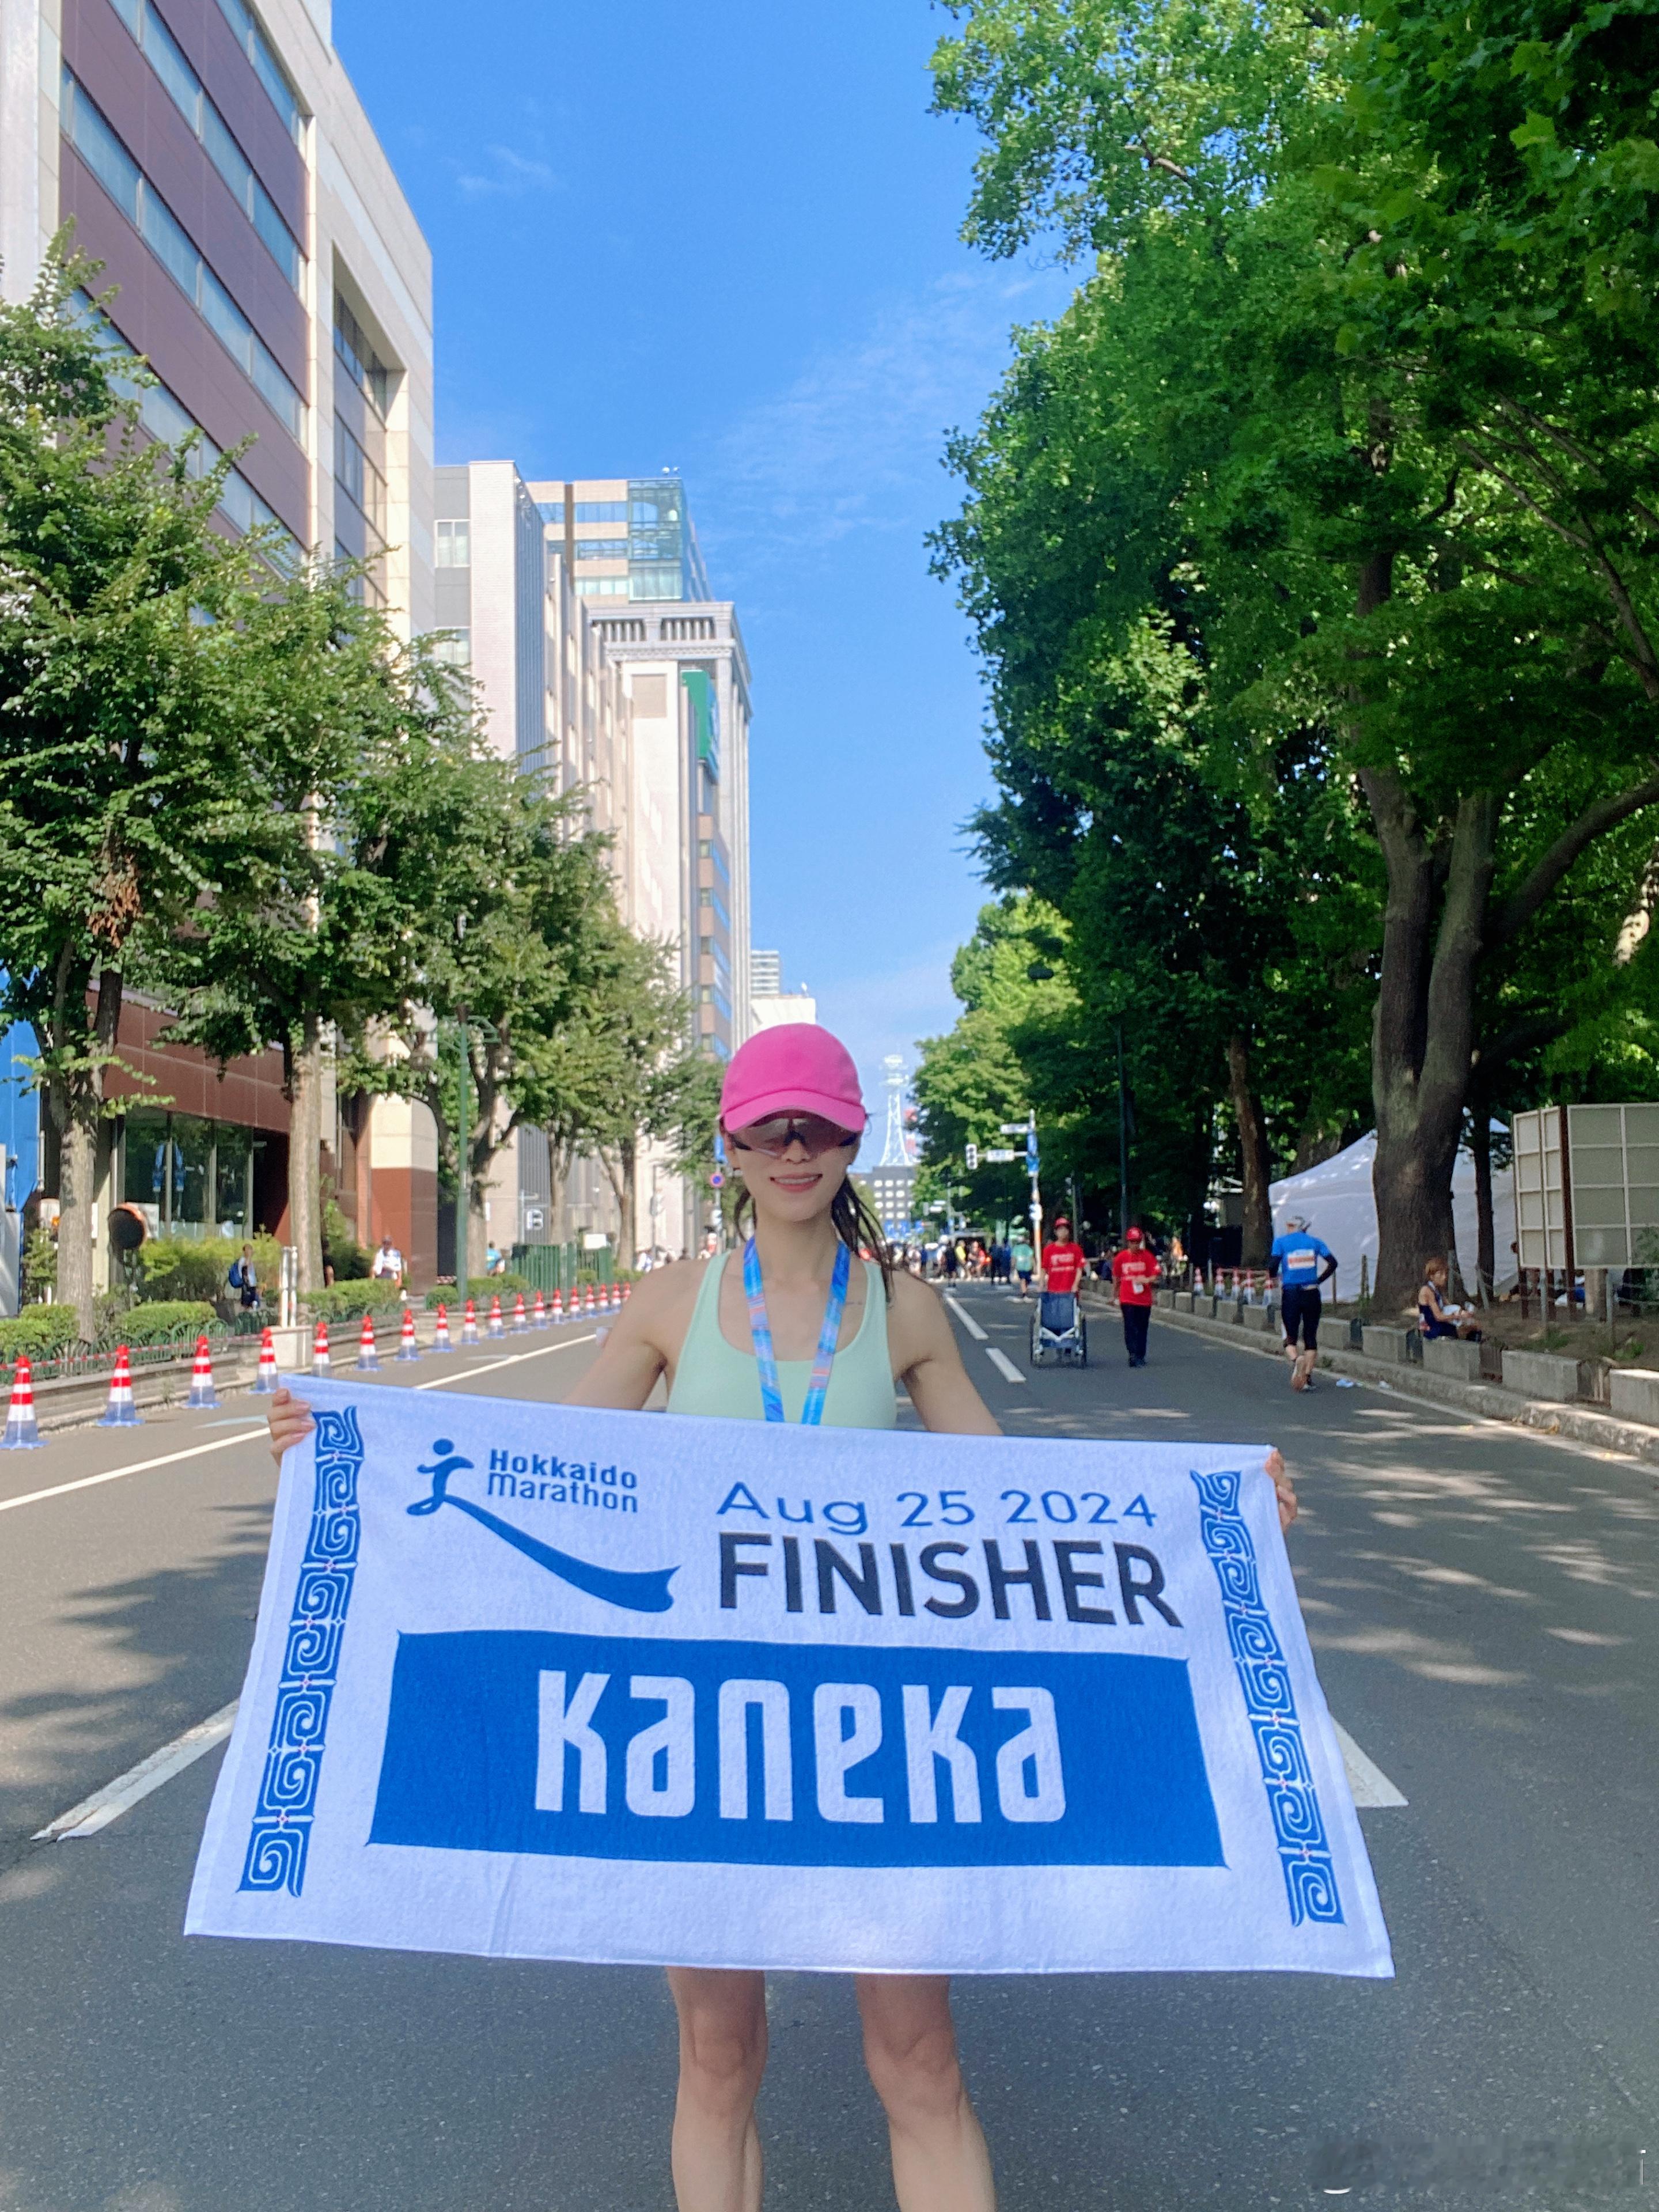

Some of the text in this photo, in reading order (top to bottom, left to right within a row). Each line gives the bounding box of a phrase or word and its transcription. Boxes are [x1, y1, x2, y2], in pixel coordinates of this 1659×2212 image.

[487, 1472, 638, 1514] Marathon
[488, 1448, 638, 1490] Hokkaido
[716, 1481, 1157, 1536] Aug 25 2024
[719, 1532, 1184, 1628] FINISHER
